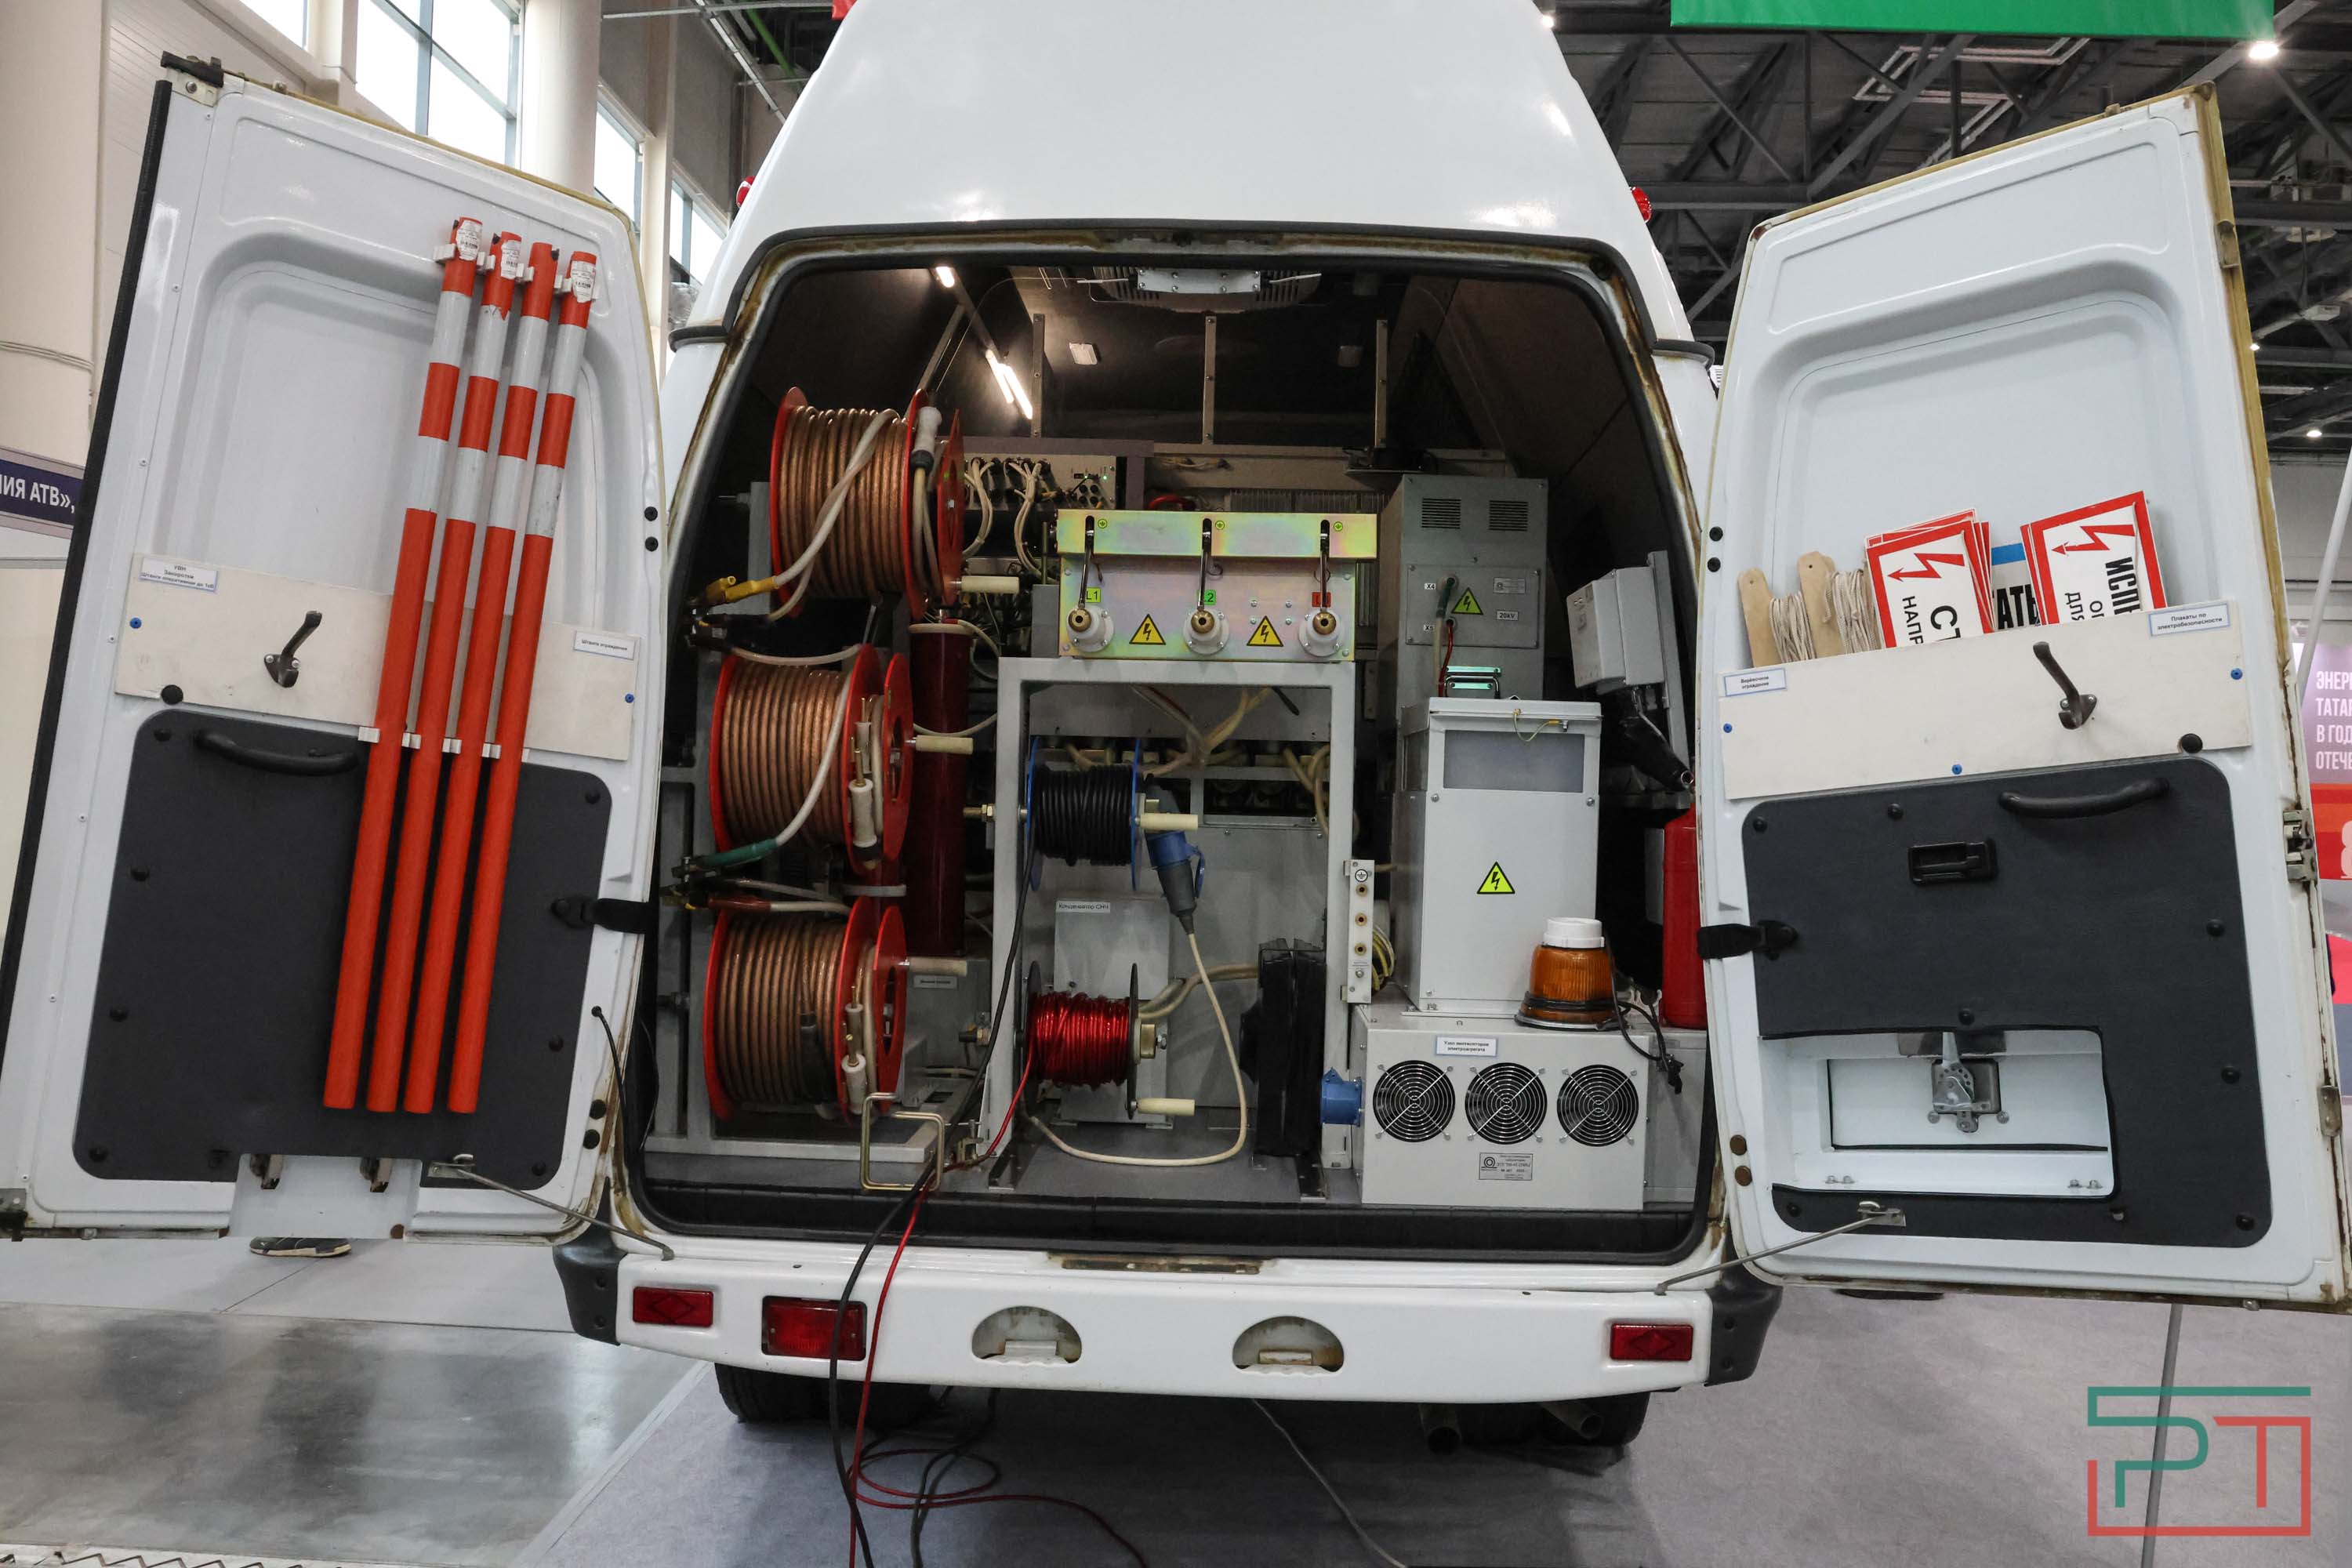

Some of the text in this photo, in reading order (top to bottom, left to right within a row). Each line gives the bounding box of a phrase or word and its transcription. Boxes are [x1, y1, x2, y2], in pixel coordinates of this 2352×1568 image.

[0, 474, 26, 499] ИЯ
[1992, 583, 2041, 630] АТЬ
[2157, 617, 2223, 630] электробезопасности
[2316, 724, 2325, 743] В
